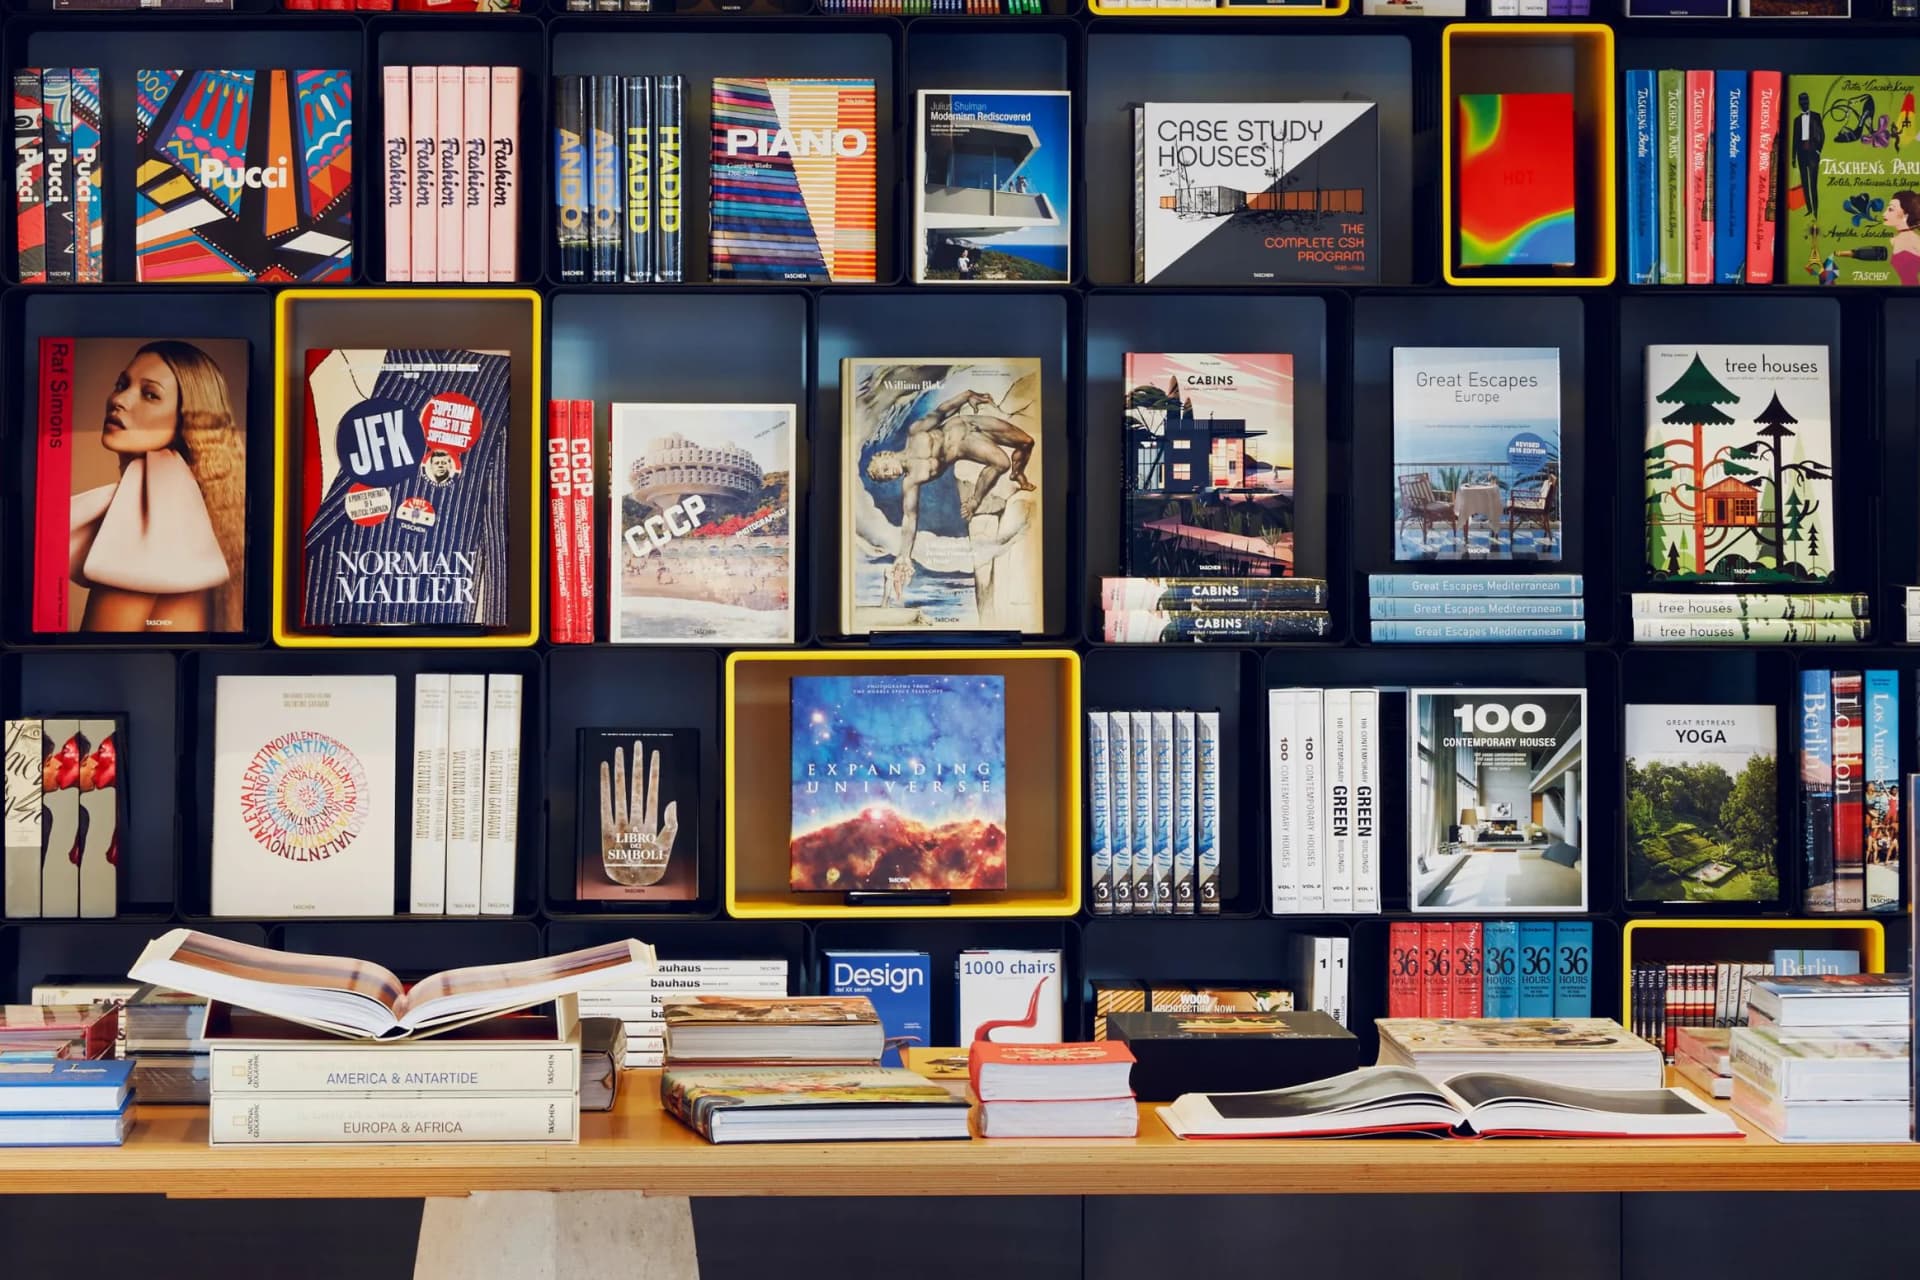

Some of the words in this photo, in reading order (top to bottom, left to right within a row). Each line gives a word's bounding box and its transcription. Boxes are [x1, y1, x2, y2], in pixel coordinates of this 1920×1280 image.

[930, 101, 952, 111] Julius
[954, 101, 987, 111] Shulman
[931, 112, 976, 121] Modernism
[978, 111, 1031, 121] Rediscovered
[1158, 119, 1228, 142] CASE
[1237, 119, 1323, 142] STUDY
[727, 128, 868, 157] PIANO
[1638, 131, 1649, 158] Berlin
[1669, 133, 1679, 159] PARIS
[1730, 131, 1741, 158] Berlin
[1159, 145, 1267, 168] HOUSES
[1821, 158, 1885, 175] TASCHEN's
[19, 148, 39, 202] Pucci
[48, 148, 69, 202] Pucci
[77, 148, 97, 202] Pucci
[200, 156, 287, 189] Pucci
[387, 137, 407, 209] Fashion
[415, 137, 434, 209] Fashion
[441, 137, 460, 209] Fashion
[466, 137, 486, 209] Fashion
[493, 137, 513, 208] Fashion
[561, 129, 582, 229] ANDO
[594, 129, 615, 229] ANDO
[628, 127, 650, 234] HADID
[659, 126, 680, 234] HADID
[1503, 170, 1535, 185] HOT
[1341, 224, 1365, 234] THE
[1265, 237, 1334, 249] COMPLETE
[1338, 237, 1365, 249] CSH
[1298, 251, 1365, 262] PROGRAM
[1852, 271, 1890, 281] TASCHEN
[50, 343, 68, 371] Raf
[1725, 357, 1757, 373] tree
[1762, 353, 1818, 373] houses
[883, 380, 920, 390] William
[1187, 375, 1233, 385] CABINS
[1417, 371, 1463, 387] Great
[1469, 371, 1538, 391] Escapes
[1455, 390, 1500, 404] Europe
[48, 381, 67, 448] Simons
[432, 400, 475, 422] SUPERMAN
[349, 409, 414, 476] JFK
[548, 438, 571, 496] CCCP
[571, 438, 594, 497] CCCP
[625, 494, 707, 559] CCCP
[336, 550, 476, 575] NORMAN
[336, 576, 476, 604] MAILER
[1192, 585, 1239, 596] CABINS
[1412, 580, 1439, 591] Great
[1442, 580, 1484, 593] Escapes
[1487, 580, 1560, 591] Mediterranean
[1414, 603, 1440, 614] Great
[1444, 603, 1486, 617] Escapes
[1489, 603, 1562, 614] Mediterranean
[1658, 602, 1685, 614] tree
[1688, 601, 1733, 614] houses
[1195, 618, 1242, 629] CABINS
[1415, 626, 1442, 637] Great
[1445, 626, 1487, 640] Escapes
[1490, 626, 1563, 637] Mediterranean
[1660, 626, 1687, 638] tree
[1690, 625, 1734, 638] houses
[1873, 693, 1889, 720] Los
[1453, 703, 1547, 734] 100
[1675, 729, 1727, 744] YOGA
[1803, 692, 1828, 769] Berlin
[1280, 737, 1288, 761] 100
[1305, 736, 1313, 760] 100
[1443, 738, 1516, 748] CONTEMPORARY
[1519, 738, 1556, 748] HOUSES
[1834, 696, 1859, 795] London
[808, 763, 990, 776] EXPANDING
[807, 781, 990, 793] UNIVERSE
[1306, 764, 1315, 833] CONTEMPORARY
[1281, 765, 1290, 834] CONTEMPORARY
[1333, 785, 1348, 837] GREEN
[1357, 785, 1372, 837] GREEN
[616, 832, 657, 843] LIBRO
[608, 849, 664, 861] SIMBOLI
[1307, 834, 1316, 868] HOUSES
[1098, 882, 1107, 899] 3
[1119, 882, 1129, 899] 3
[1138, 882, 1148, 899] 3
[1159, 882, 1169, 899] 3
[1180, 882, 1190, 899] 3
[1204, 882, 1215, 899] 3
[658, 964, 702, 973] auhaus
[964, 960, 1004, 975] 1000
[1010, 959, 1057, 975] chairs
[1320, 958, 1326, 968] 1
[1337, 958, 1343, 968] 1
[1392, 947, 1419, 977] 36
[1423, 947, 1450, 977] 36
[1455, 947, 1481, 977] 36
[1486, 946, 1515, 976] 36
[1522, 946, 1551, 976] 36
[1559, 946, 1588, 976] 36
[1781, 958, 1839, 976] Berlin
[650, 978, 701, 988] bauhaus
[834, 962, 924, 994] Design
[1486, 975, 1516, 985] HOURS
[1521, 975, 1551, 984] HOURS
[1559, 975, 1589, 984] HOURS
[1181, 994, 1211, 1005] WOOD
[327, 1072, 388, 1085] AMERICA
[391, 1072, 401, 1085] &
[404, 1072, 478, 1085] ANTARTIDE
[547, 1054, 555, 1085] TASCHEN
[343, 1122, 397, 1134] EUROPA
[400, 1122, 410, 1134] &
[413, 1122, 463, 1134] AFRICA
[547, 1103, 555, 1134] TASCHEN
